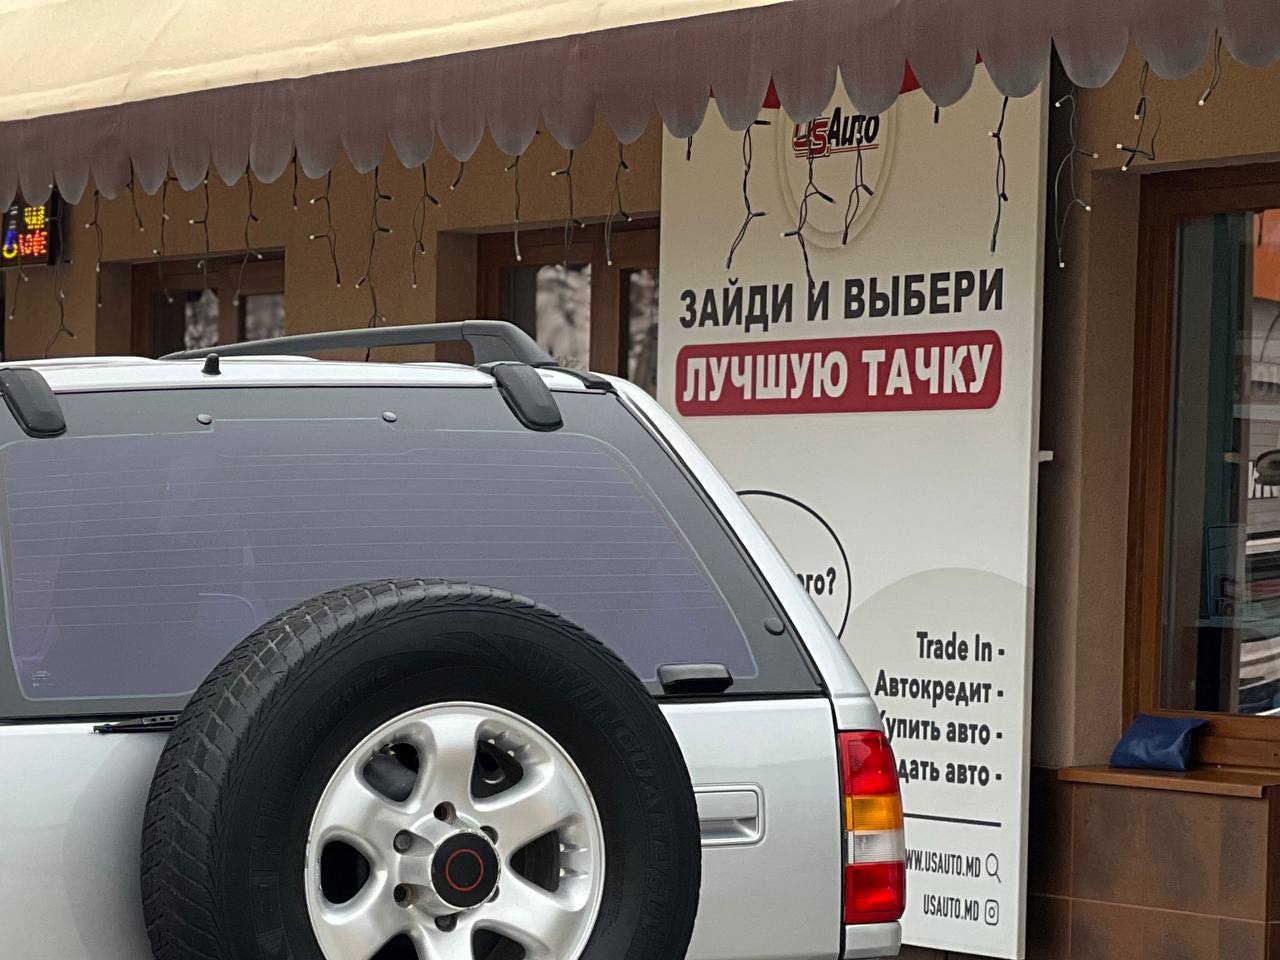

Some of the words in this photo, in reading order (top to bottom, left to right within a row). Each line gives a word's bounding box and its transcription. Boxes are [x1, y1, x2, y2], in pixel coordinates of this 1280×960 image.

[679, 277, 792, 332] ЗАЙДИ
[807, 281, 829, 321] И
[844, 268, 1004, 319] ВЫБЕРИ
[683, 351, 848, 401] ЛУЧШУЮ
[862, 344, 993, 396] ТАЧКУ
[917, 631, 968, 661] Trade
[975, 634, 992, 662] In
[874, 669, 992, 708] Автокредит
[880, 710, 941, 744] упить
[946, 722, 991, 745] авто
[898, 759, 940, 783] дать
[945, 763, 990, 786] авто
[905, 848, 981, 878] WW.USAUTO.MD
[923, 894, 979, 921] USAUTO.MD
